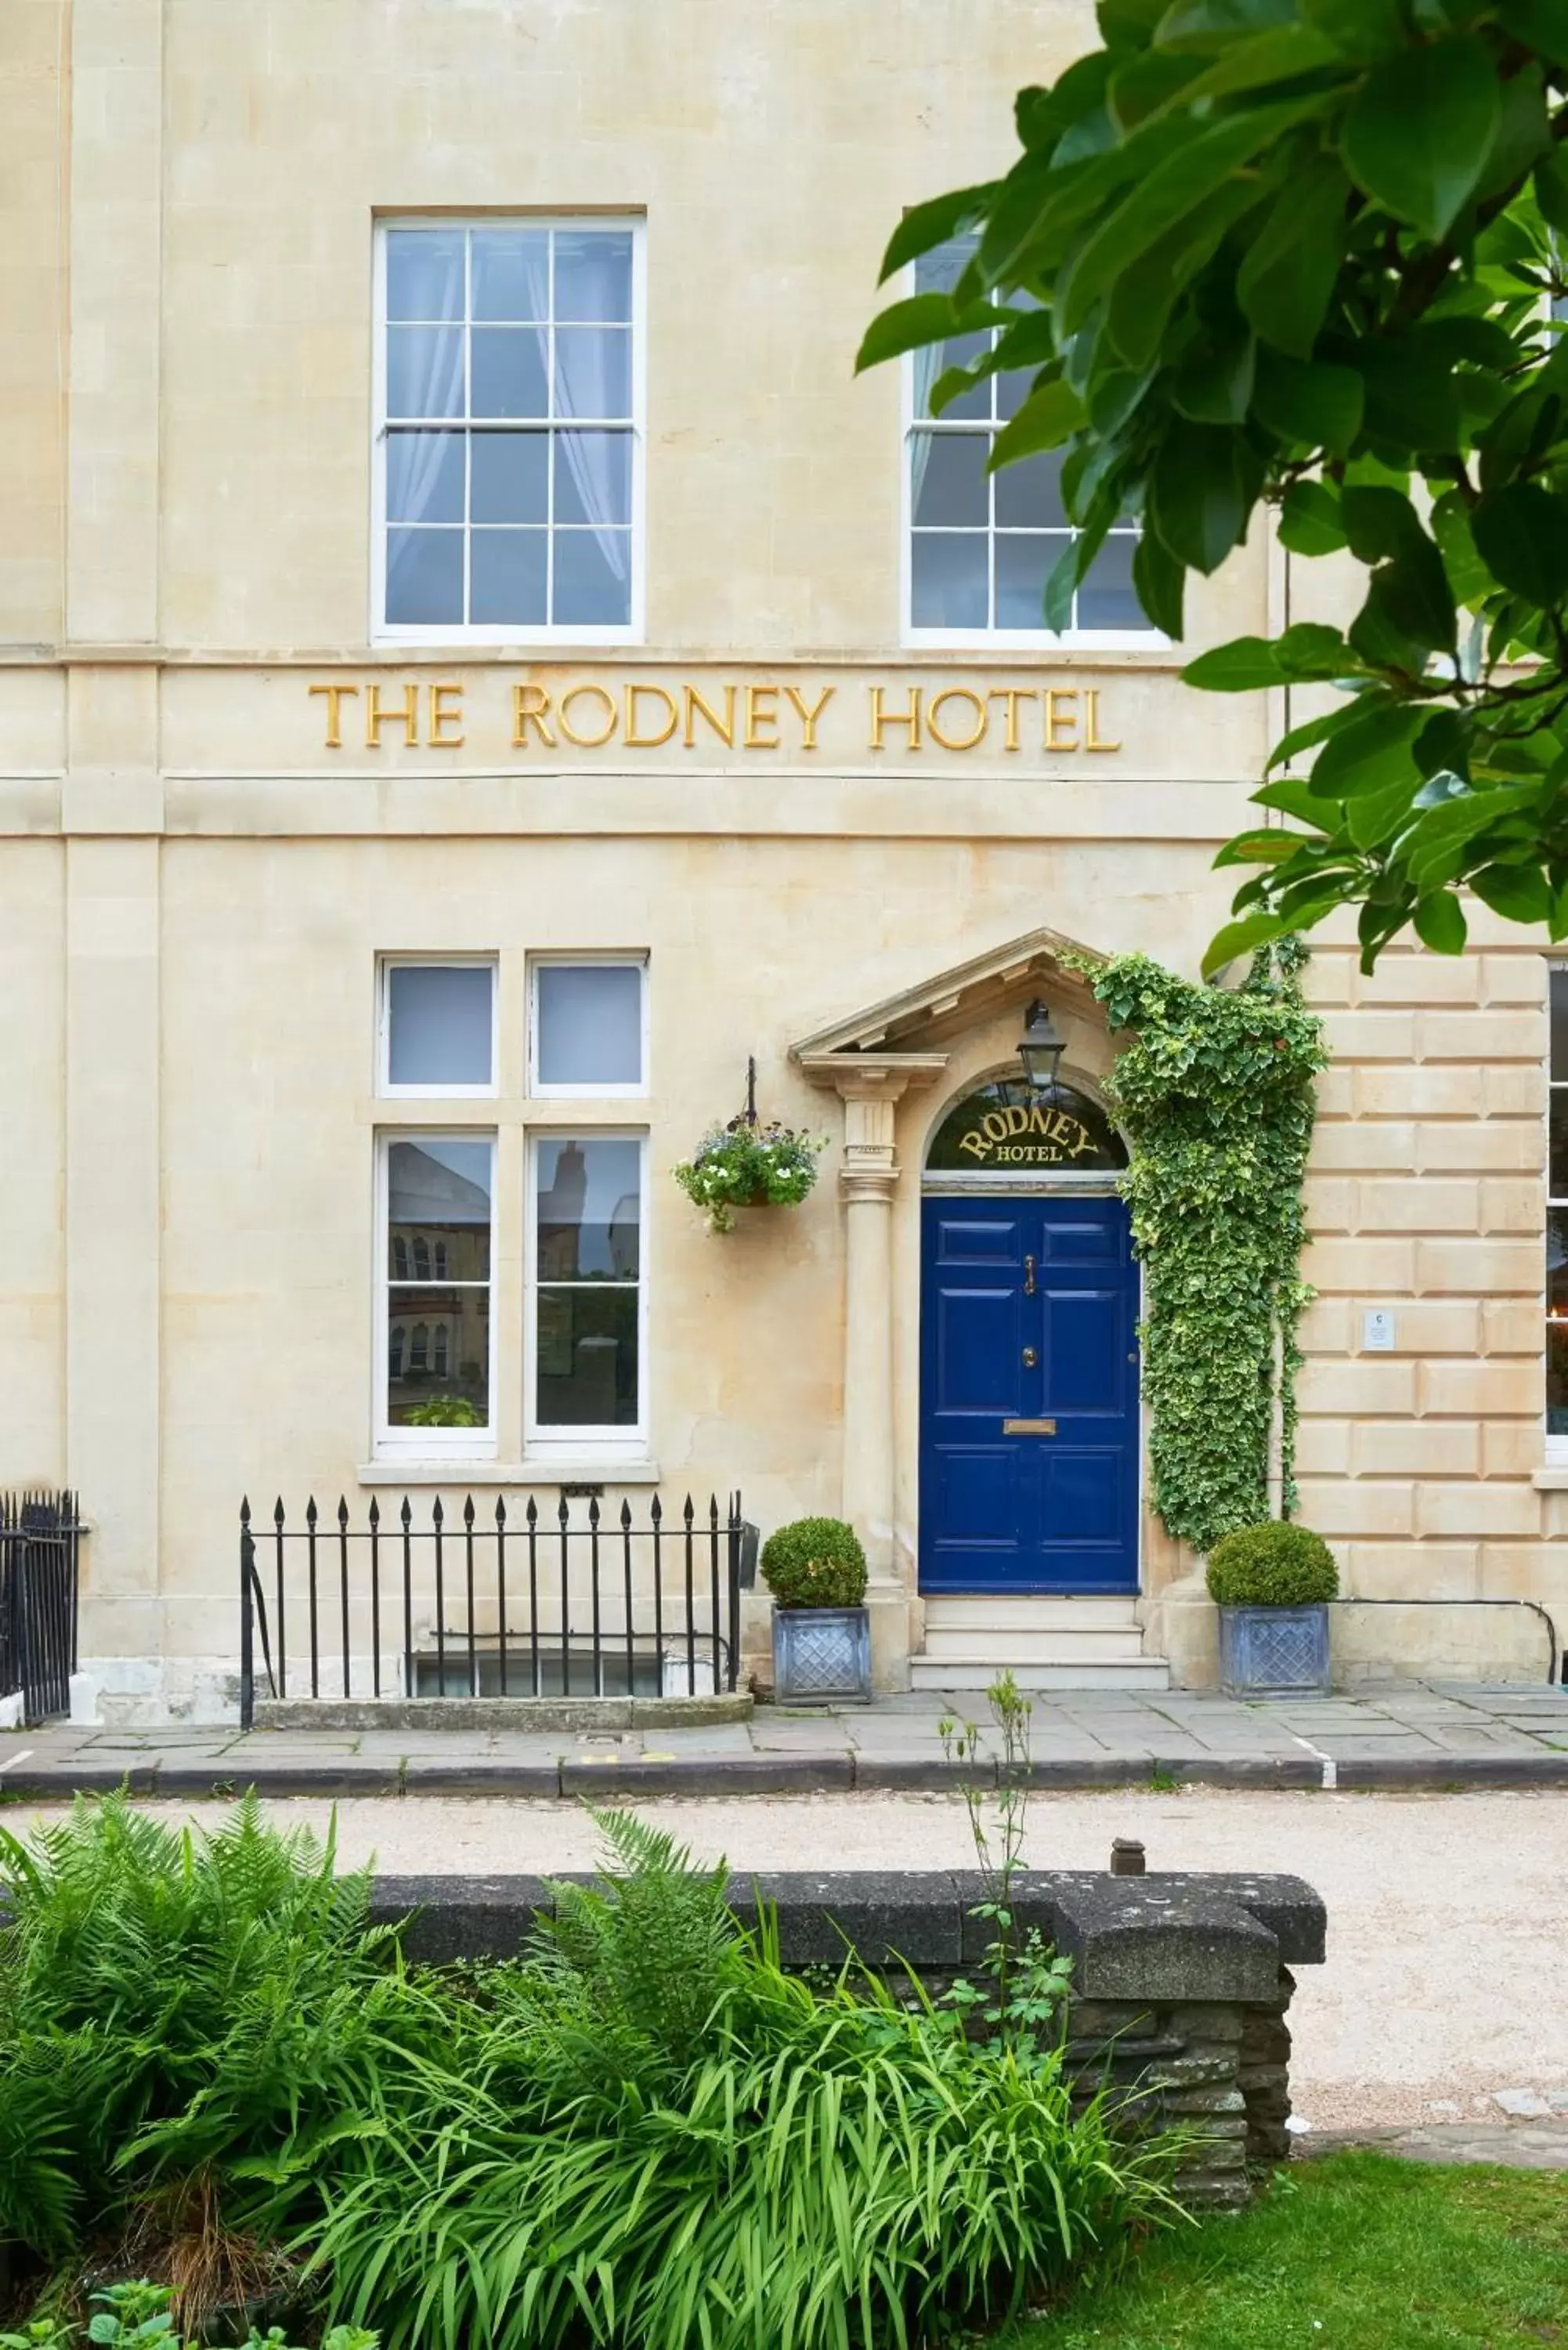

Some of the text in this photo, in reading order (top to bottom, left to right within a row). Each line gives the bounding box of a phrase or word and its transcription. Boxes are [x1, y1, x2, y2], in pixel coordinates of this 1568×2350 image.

[309, 684, 1122, 751] THE RODNEY HOTEL
[959, 1105, 1099, 1160] RODNEY
[995, 1145, 1063, 1162] HOTEL
